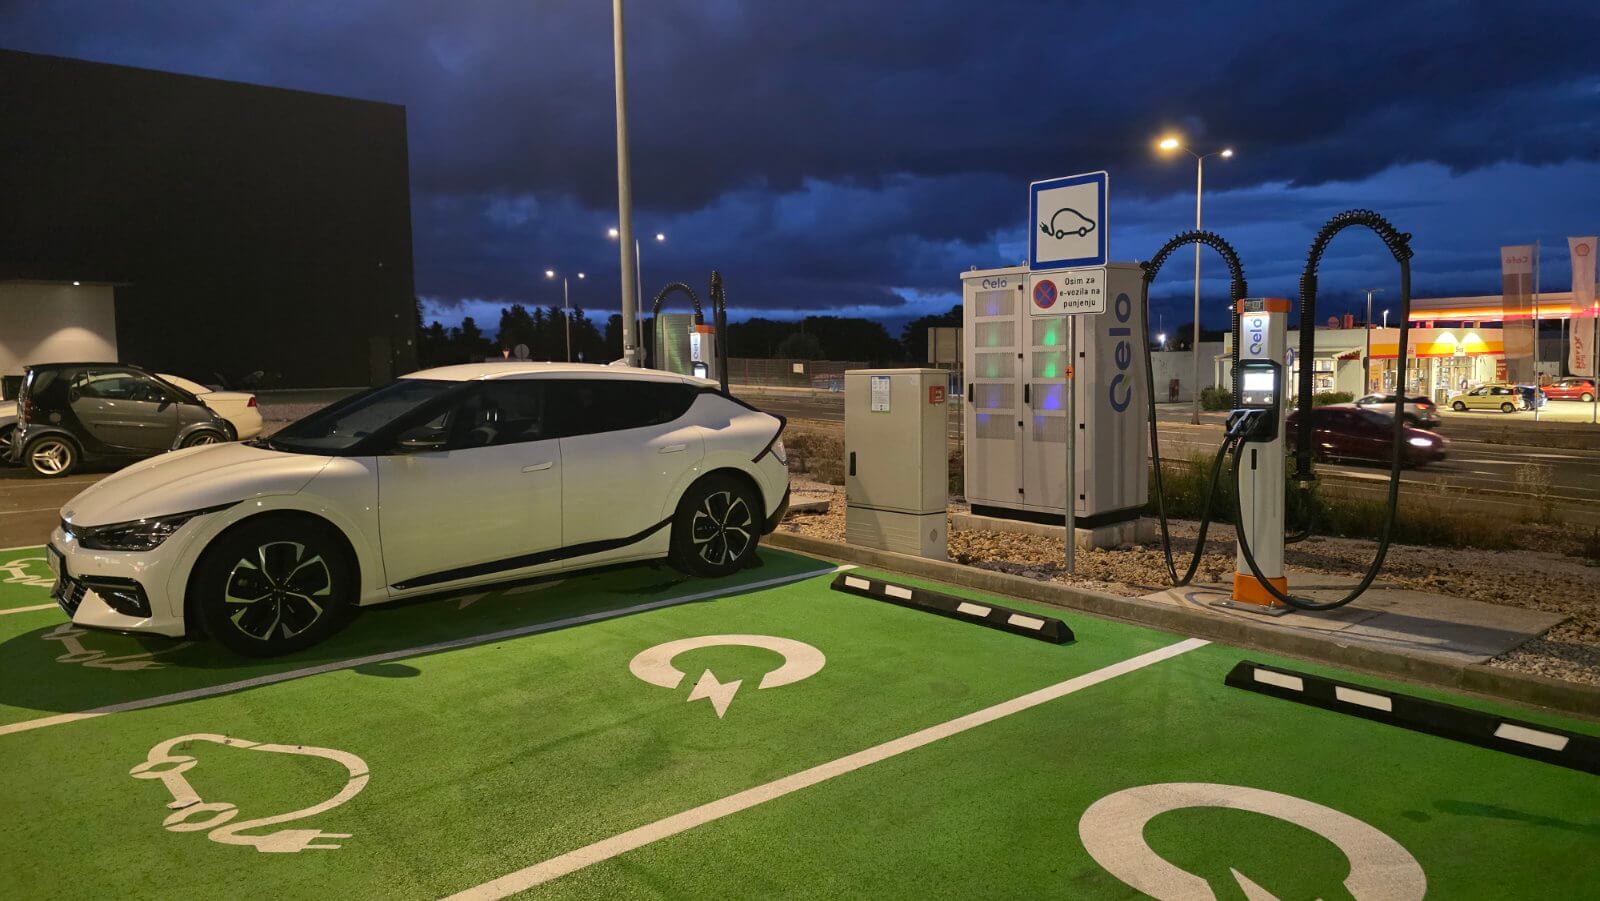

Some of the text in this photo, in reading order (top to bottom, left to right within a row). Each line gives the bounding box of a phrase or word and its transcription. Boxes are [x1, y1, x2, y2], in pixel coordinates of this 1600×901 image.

[1064, 277, 1095, 286] Osim za
[1059, 289, 1089, 297] e-vozila
[1063, 299, 1096, 308] punjenju
[1109, 293, 1132, 412] Qelo
